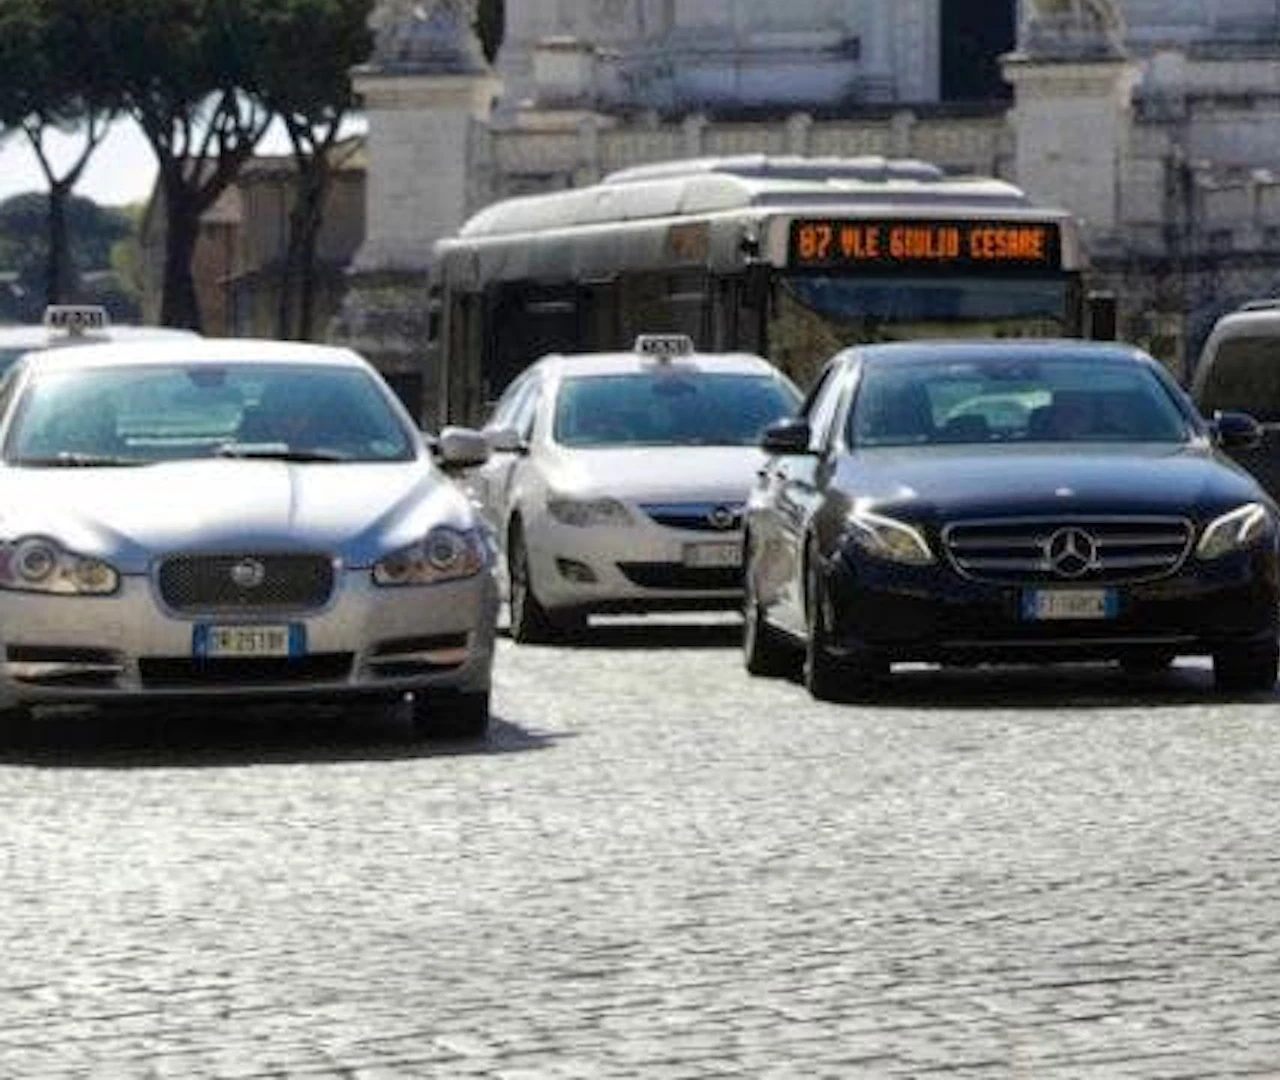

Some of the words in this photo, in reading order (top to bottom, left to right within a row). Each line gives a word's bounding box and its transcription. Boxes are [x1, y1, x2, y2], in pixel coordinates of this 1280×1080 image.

[799, 225, 831, 259] 87
[889, 226, 959, 258] GIULIO
[970, 227, 1044, 259] CESARE
